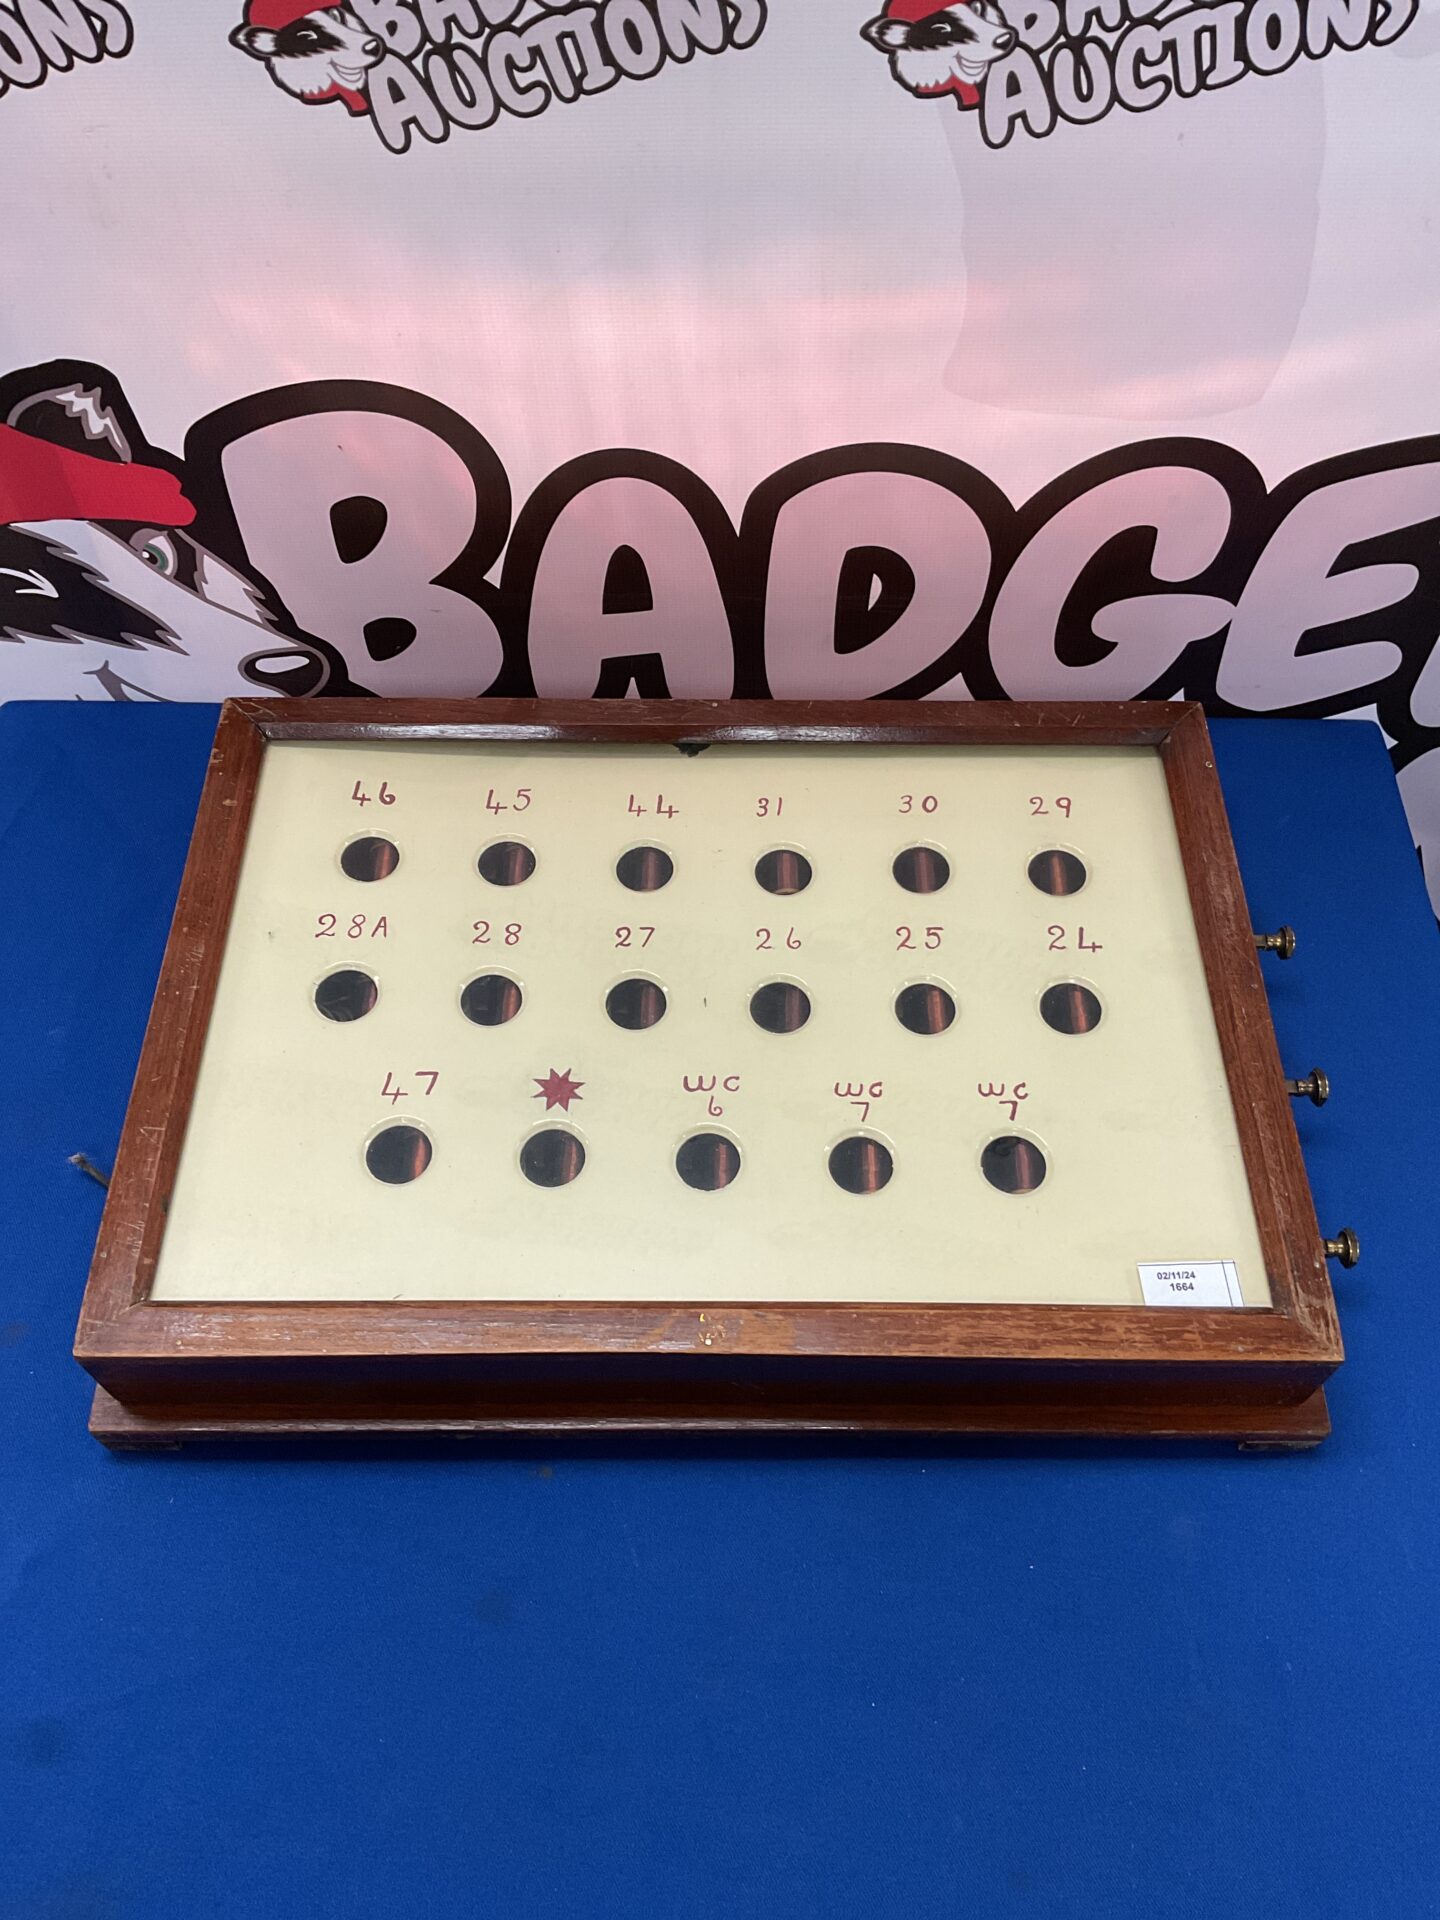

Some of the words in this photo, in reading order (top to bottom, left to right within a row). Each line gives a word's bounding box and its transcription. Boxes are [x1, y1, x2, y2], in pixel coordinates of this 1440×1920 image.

[186, 380, 1440, 742] BADGE
[351, 780, 396, 807] 46
[485, 788, 531, 815] 45
[898, 794, 939, 814] 30
[628, 794, 680, 819] 44
[756, 797, 783, 817] 31
[1029, 796, 1072, 818] 29
[472, 920, 522, 946] 28
[614, 926, 656, 949] 27
[755, 927, 802, 951] 26
[895, 926, 944, 951] 25
[1047, 924, 1103, 953] 24
[381, 1071, 440, 1106] 47
[707, 1095, 724, 1118] 6
[850, 1101, 870, 1123] 7
[999, 1100, 1019, 1121] 7
[1156, 1271, 1196, 1280] 02/11/24
[1169, 1282, 1195, 1291] 1664
